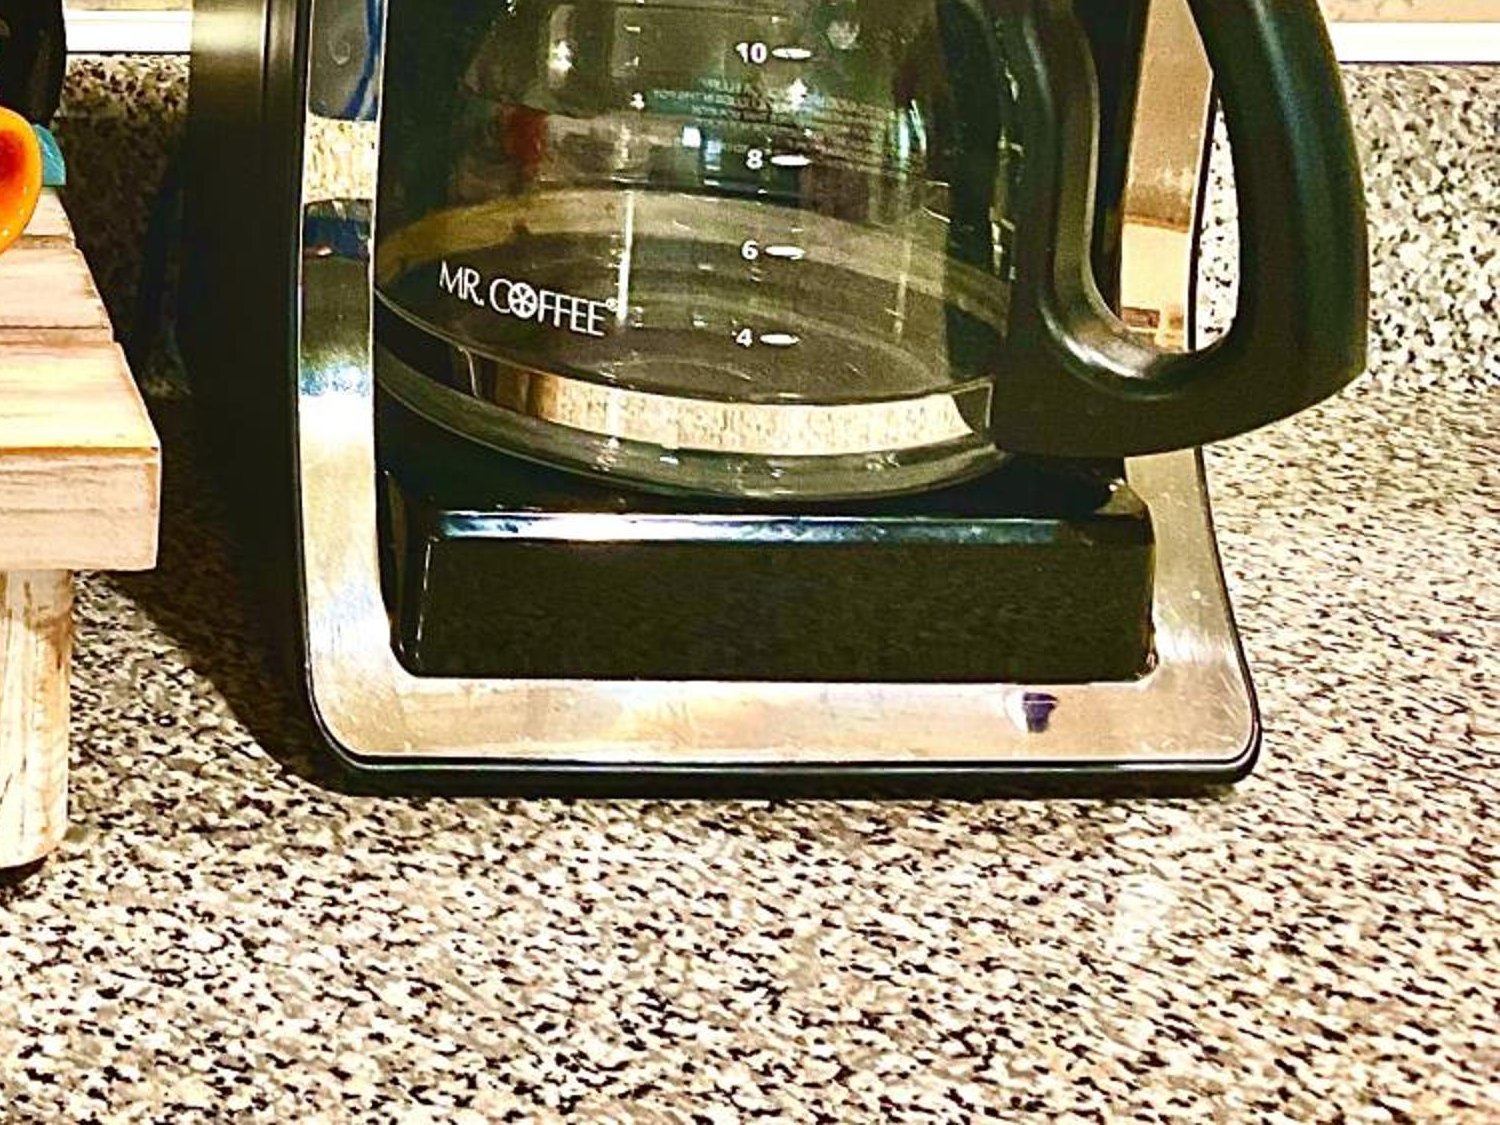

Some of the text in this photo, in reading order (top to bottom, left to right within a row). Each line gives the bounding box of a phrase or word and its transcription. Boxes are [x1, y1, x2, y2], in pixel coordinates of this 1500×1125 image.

[736, 41, 767, 65] 10
[746, 148, 764, 171] 8
[740, 240, 760, 261] 6
[439, 260, 485, 307] MR.
[736, 328, 753, 347] 4
